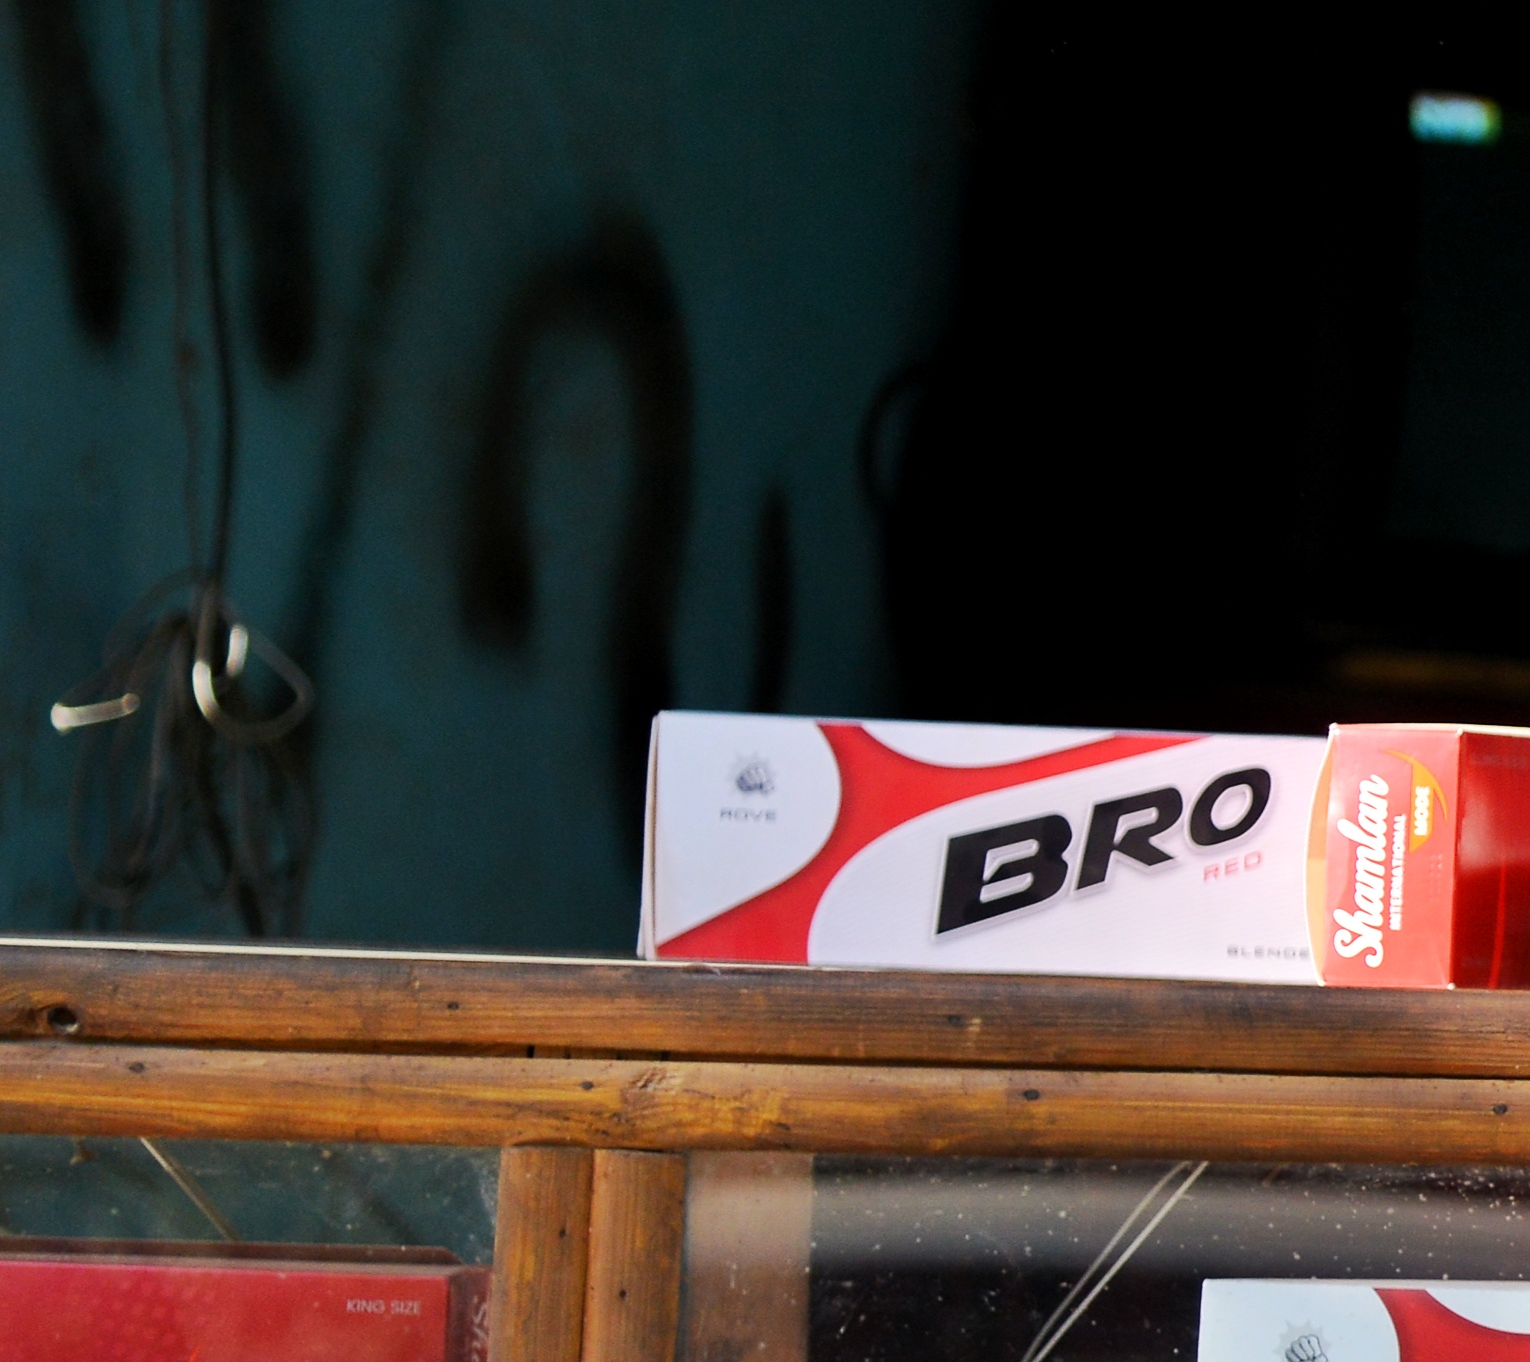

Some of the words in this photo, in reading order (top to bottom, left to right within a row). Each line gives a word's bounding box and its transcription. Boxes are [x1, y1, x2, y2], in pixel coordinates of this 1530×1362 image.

[719, 808, 777, 823] ROVE
[1414, 785, 1431, 837] MODE
[934, 766, 1272, 937] BRO
[1202, 851, 1264, 883] RED
[1333, 773, 1389, 969] Shamlan
[1388, 814, 1406, 931] INTERNATIONAL
[346, 1299, 385, 1315] KING
[389, 1299, 422, 1316] SIZE
